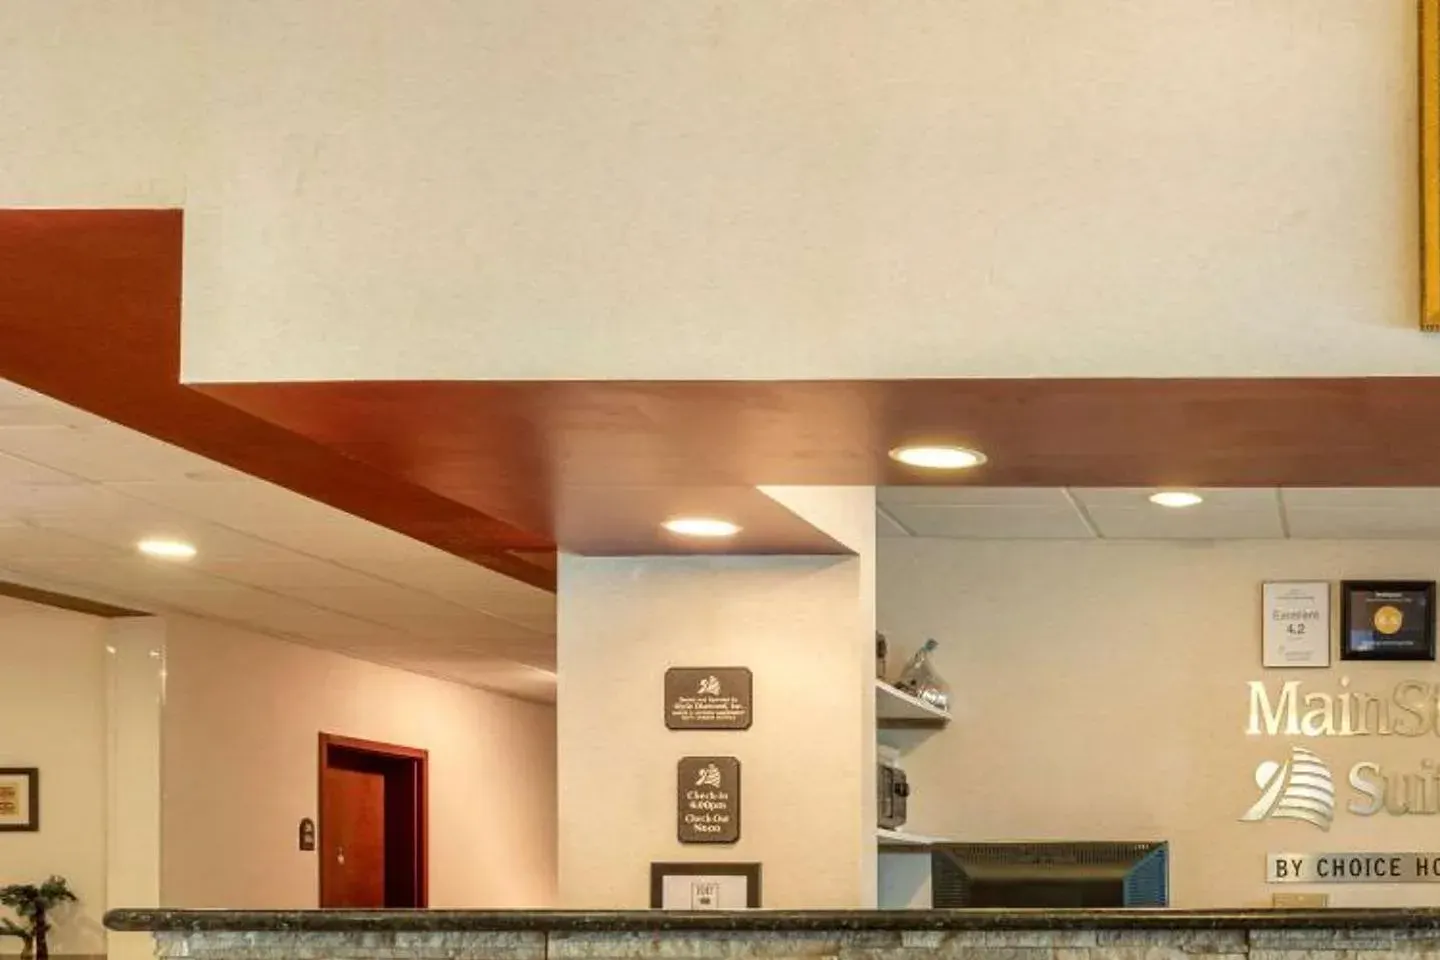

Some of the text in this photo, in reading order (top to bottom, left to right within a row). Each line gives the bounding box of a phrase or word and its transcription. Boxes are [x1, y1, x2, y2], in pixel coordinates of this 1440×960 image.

[1286, 622, 1307, 635] 4.2
[1275, 859, 1303, 878] BY
[1316, 857, 1402, 878] CHOICE
